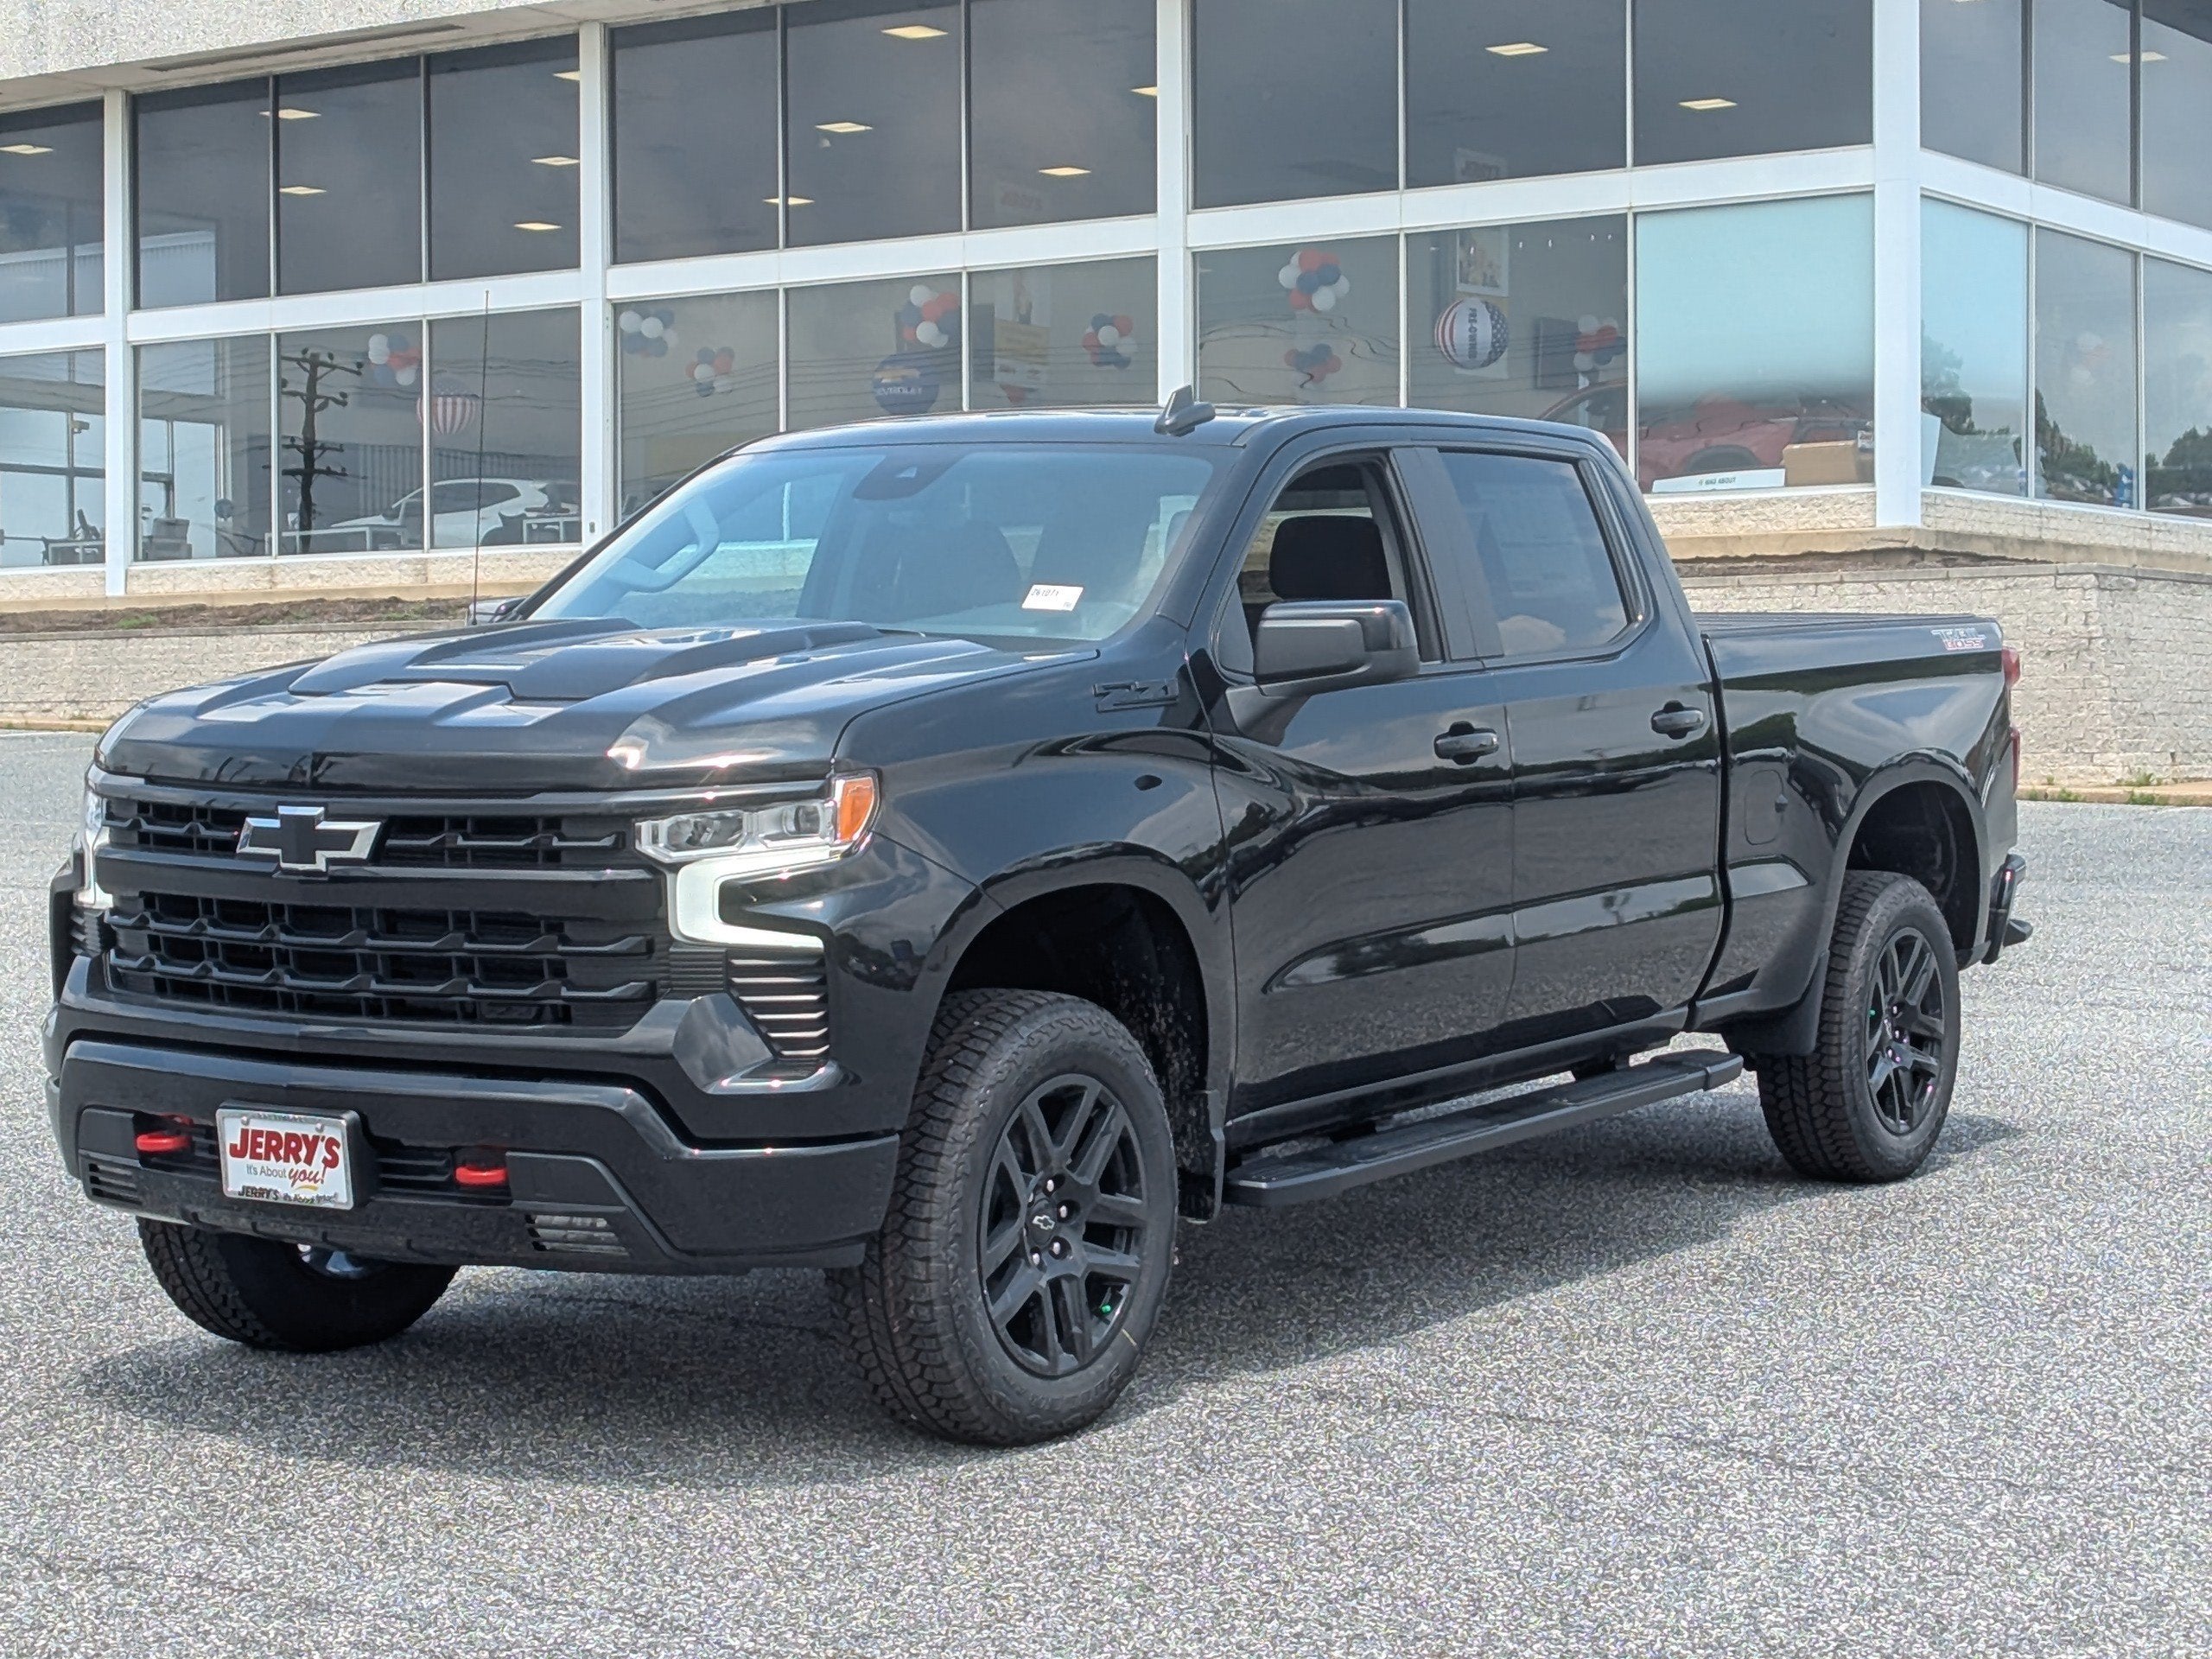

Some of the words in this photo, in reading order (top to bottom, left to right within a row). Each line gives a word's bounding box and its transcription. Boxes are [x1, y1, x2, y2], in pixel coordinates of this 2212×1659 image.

[1943, 639, 1984, 651] BOSS
[229, 1128, 341, 1169] JERRY'S
[246, 1164, 258, 1176] It's
[259, 1166, 287, 1179] About
[288, 1165, 327, 1188] you!
